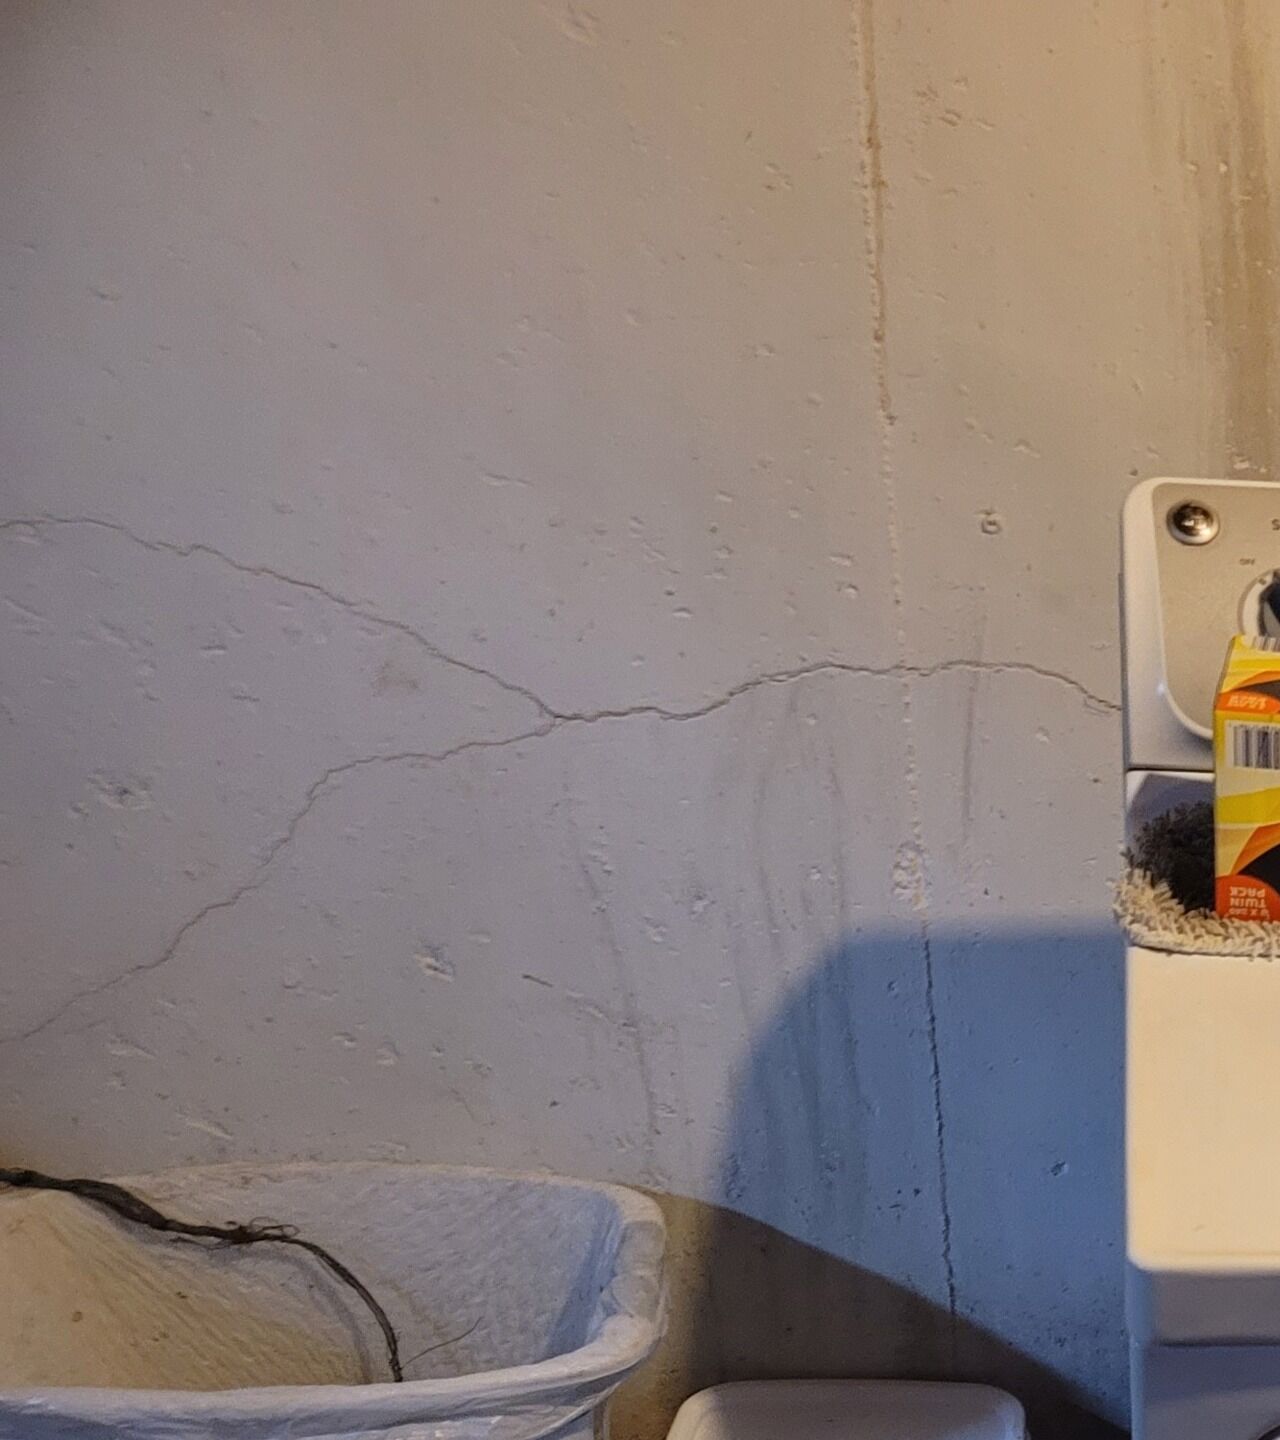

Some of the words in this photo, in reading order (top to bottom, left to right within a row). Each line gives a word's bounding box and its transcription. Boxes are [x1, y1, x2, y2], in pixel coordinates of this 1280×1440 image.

[1239, 558, 1256, 566] OFF
[1230, 886, 1266, 898] PACK
[1230, 897, 1266, 909] TWIN
